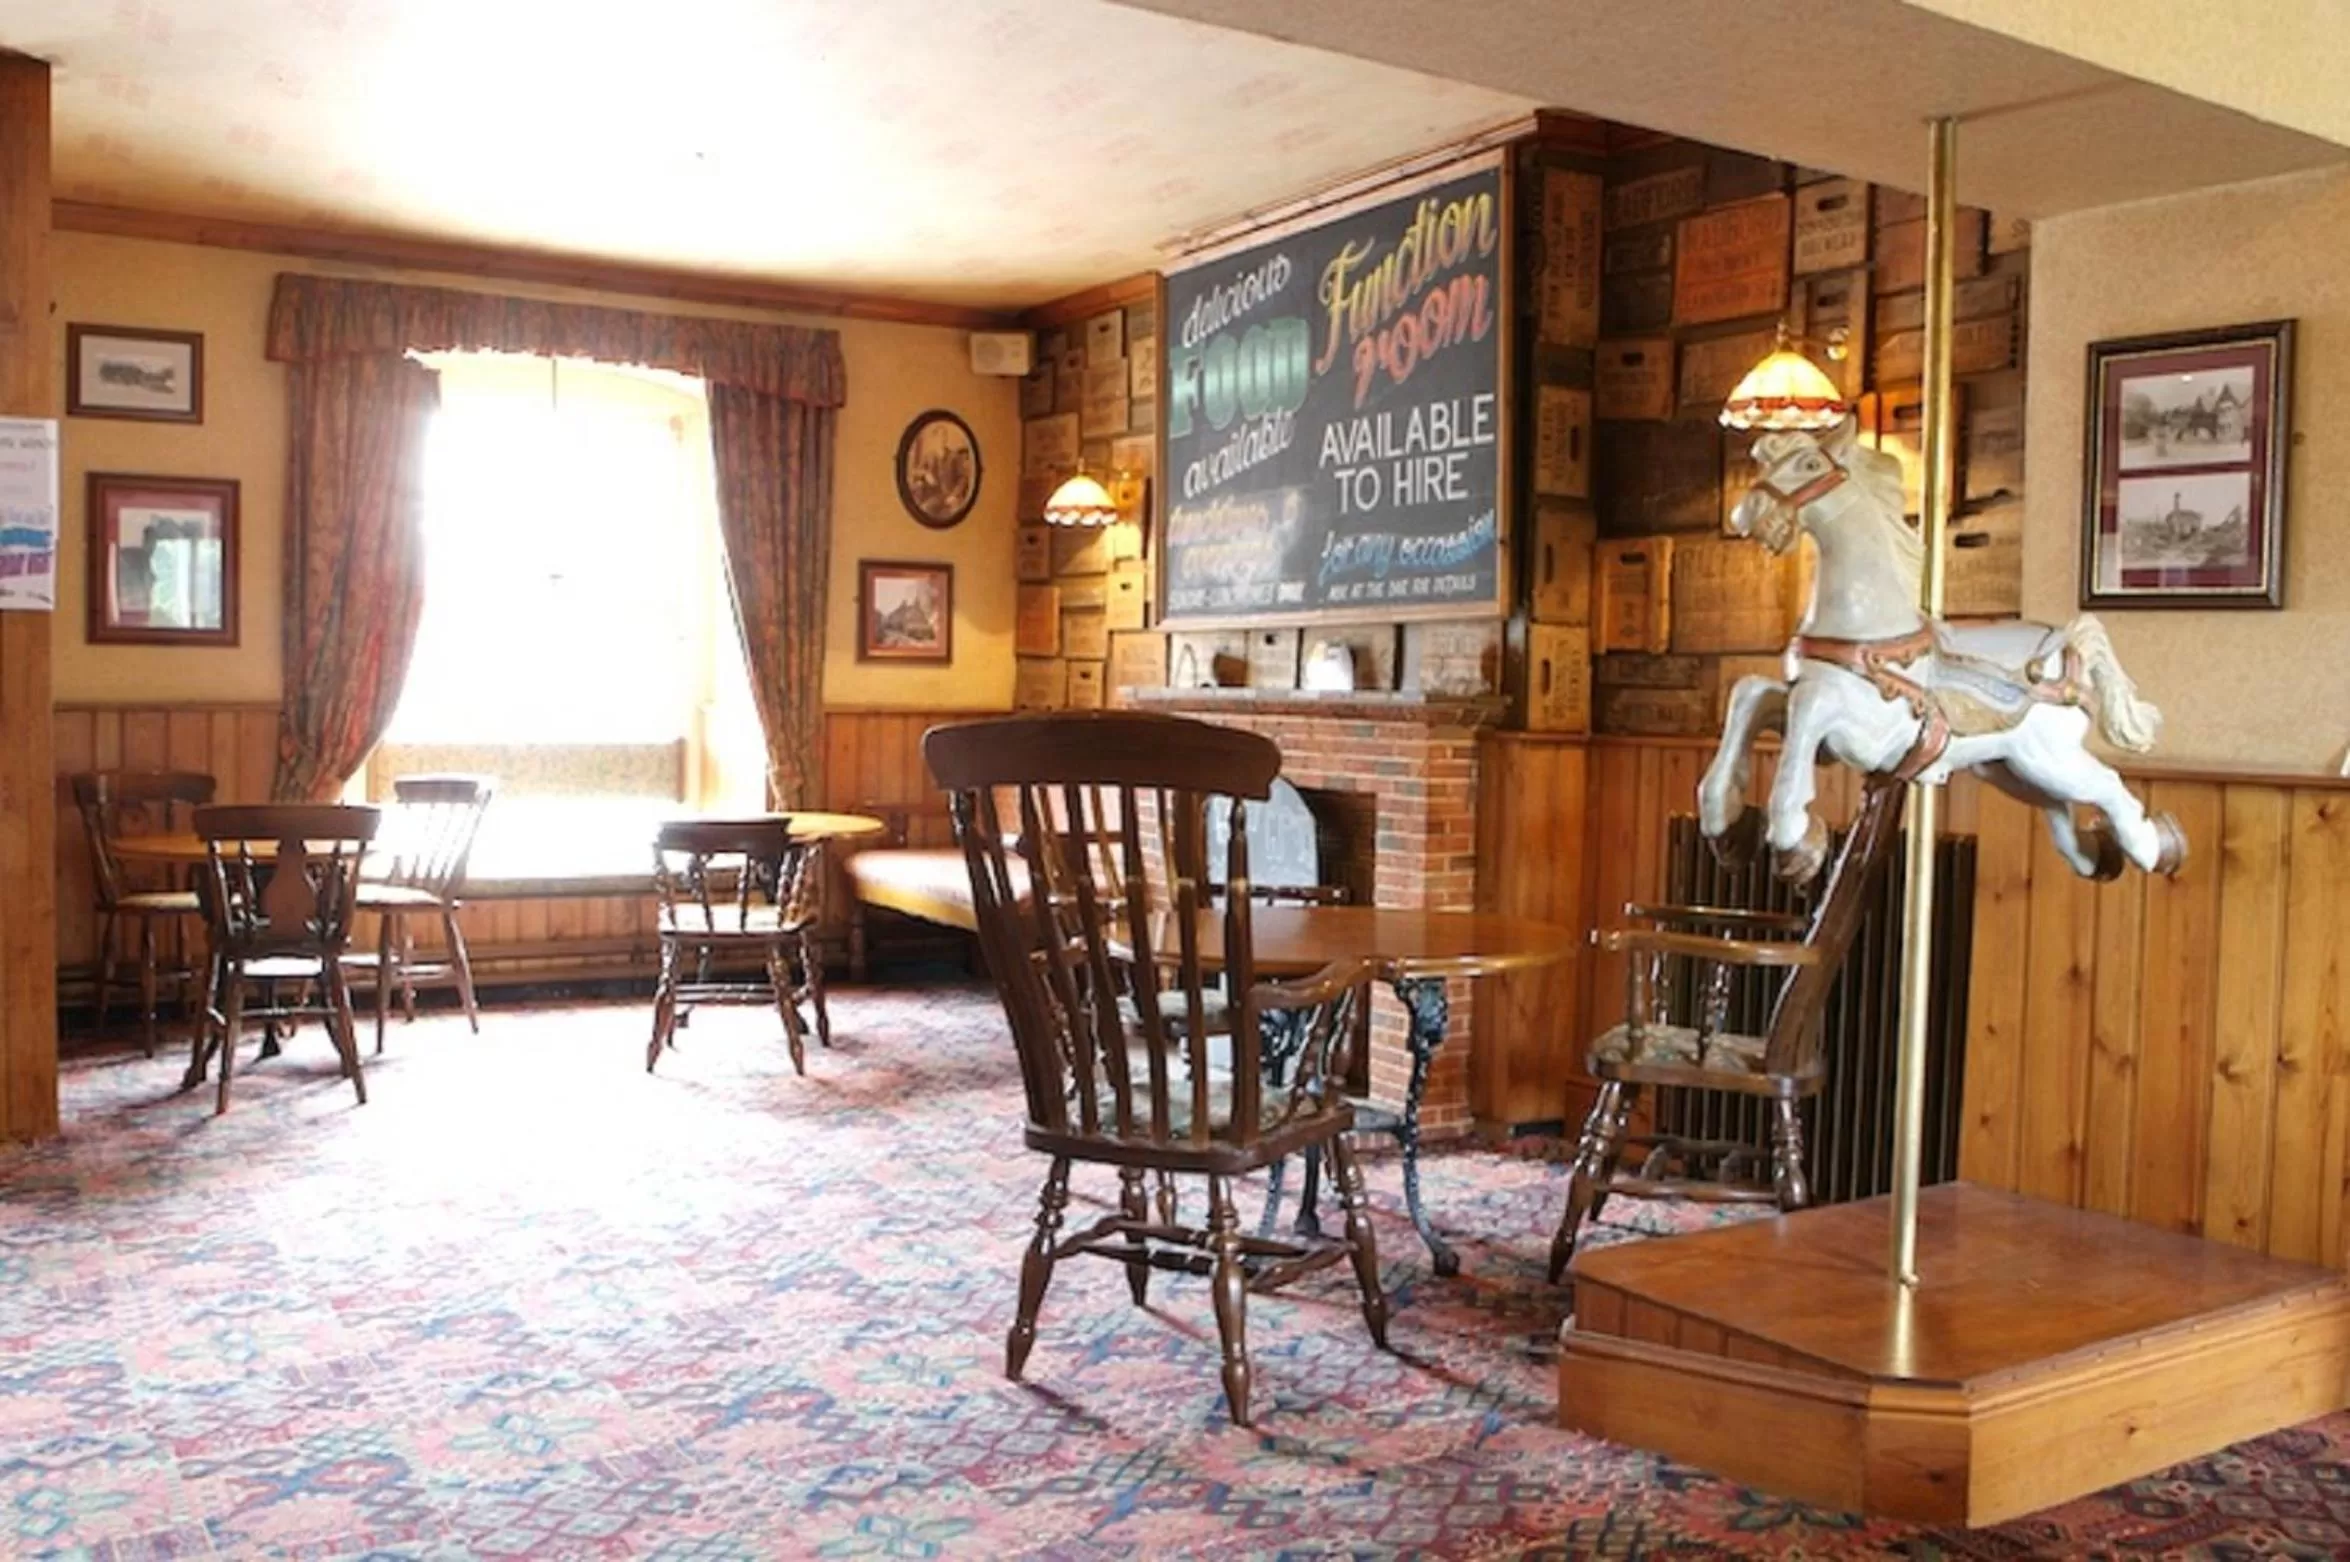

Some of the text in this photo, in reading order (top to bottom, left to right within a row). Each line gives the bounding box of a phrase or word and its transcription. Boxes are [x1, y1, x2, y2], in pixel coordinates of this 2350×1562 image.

[1182, 253, 1292, 349] delicious
[1315, 193, 1497, 376] Function
[1168, 315, 1311, 438] FOOD
[1353, 273, 1493, 410] room
[1183, 406, 1296, 499] available
[1319, 393, 1496, 469] AVAILABLE
[1334, 452, 1469, 514] TO HIRE
